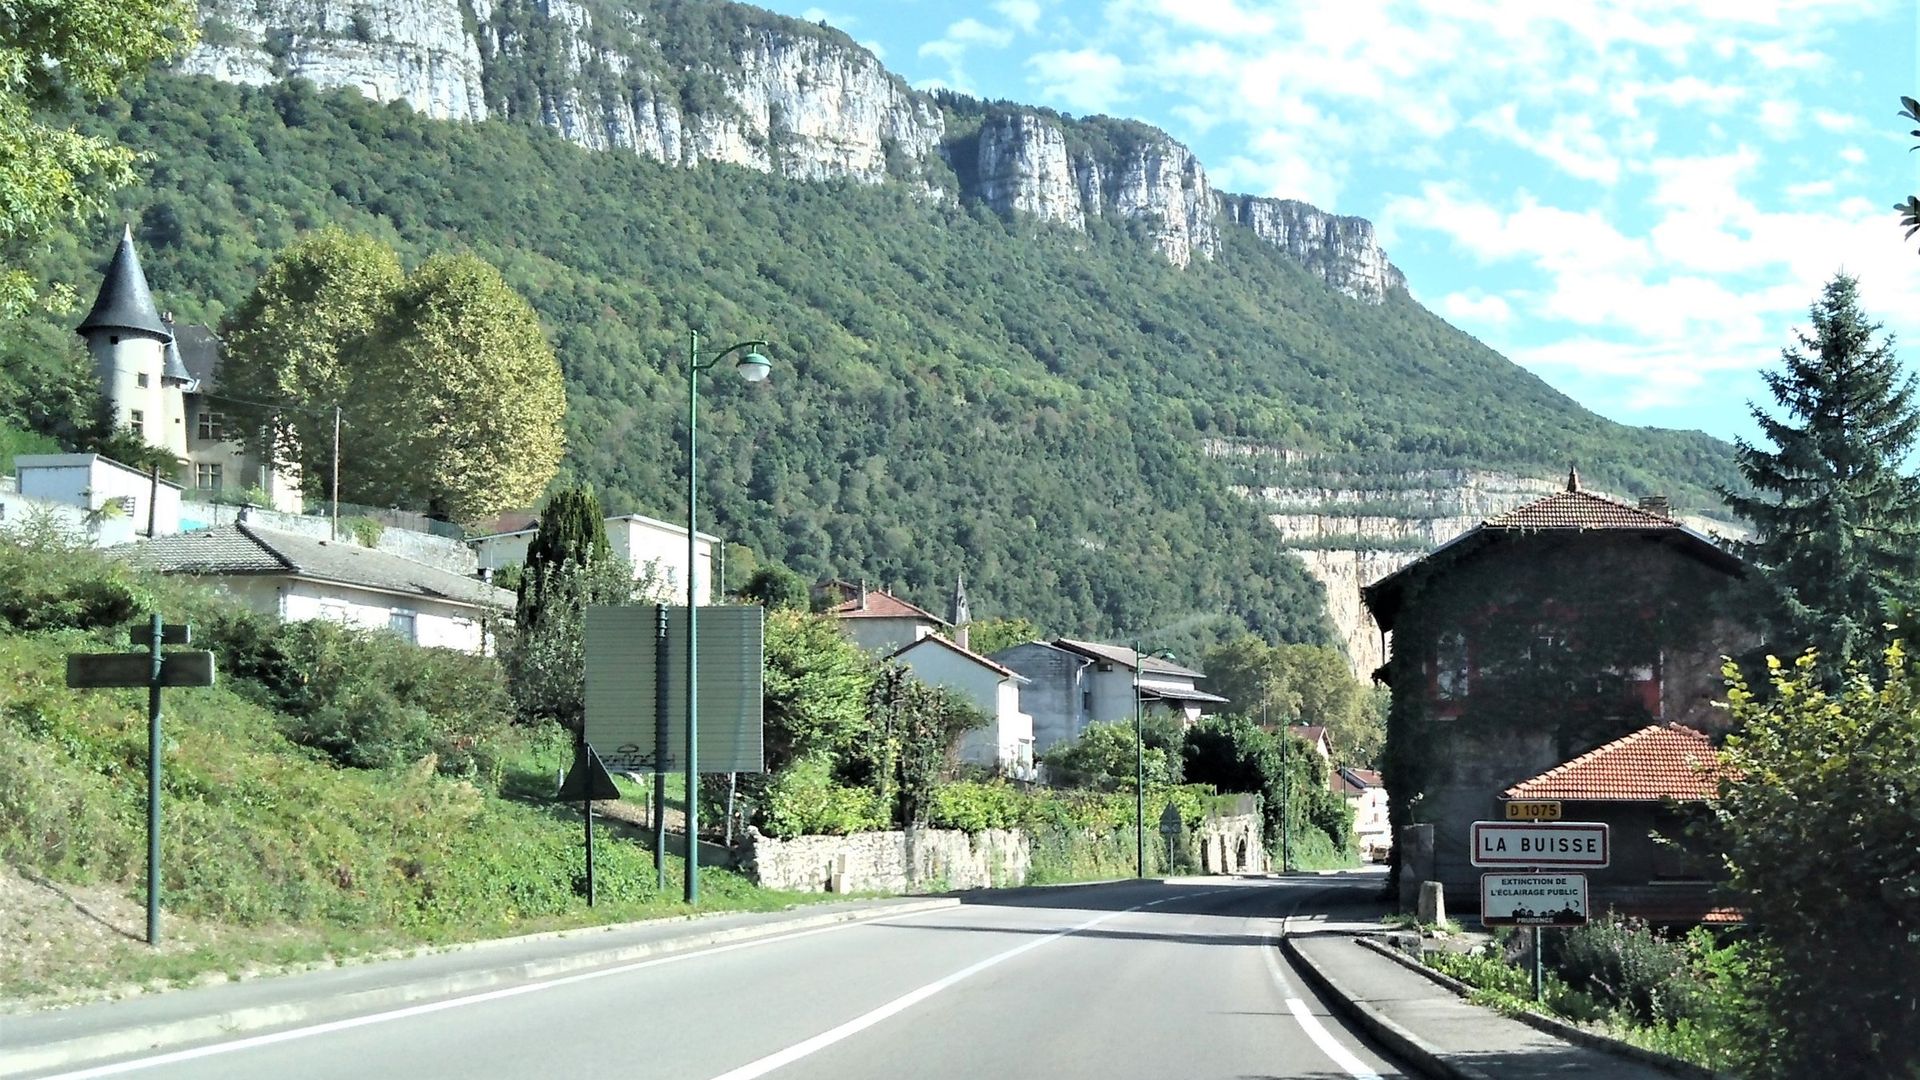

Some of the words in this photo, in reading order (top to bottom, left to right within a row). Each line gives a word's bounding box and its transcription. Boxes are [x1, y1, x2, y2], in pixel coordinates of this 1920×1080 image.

[1511, 805, 1519, 816] D
[1525, 805, 1557, 816] 1075
[1485, 837, 1507, 852] LA
[1521, 837, 1596, 853] BUISSE
